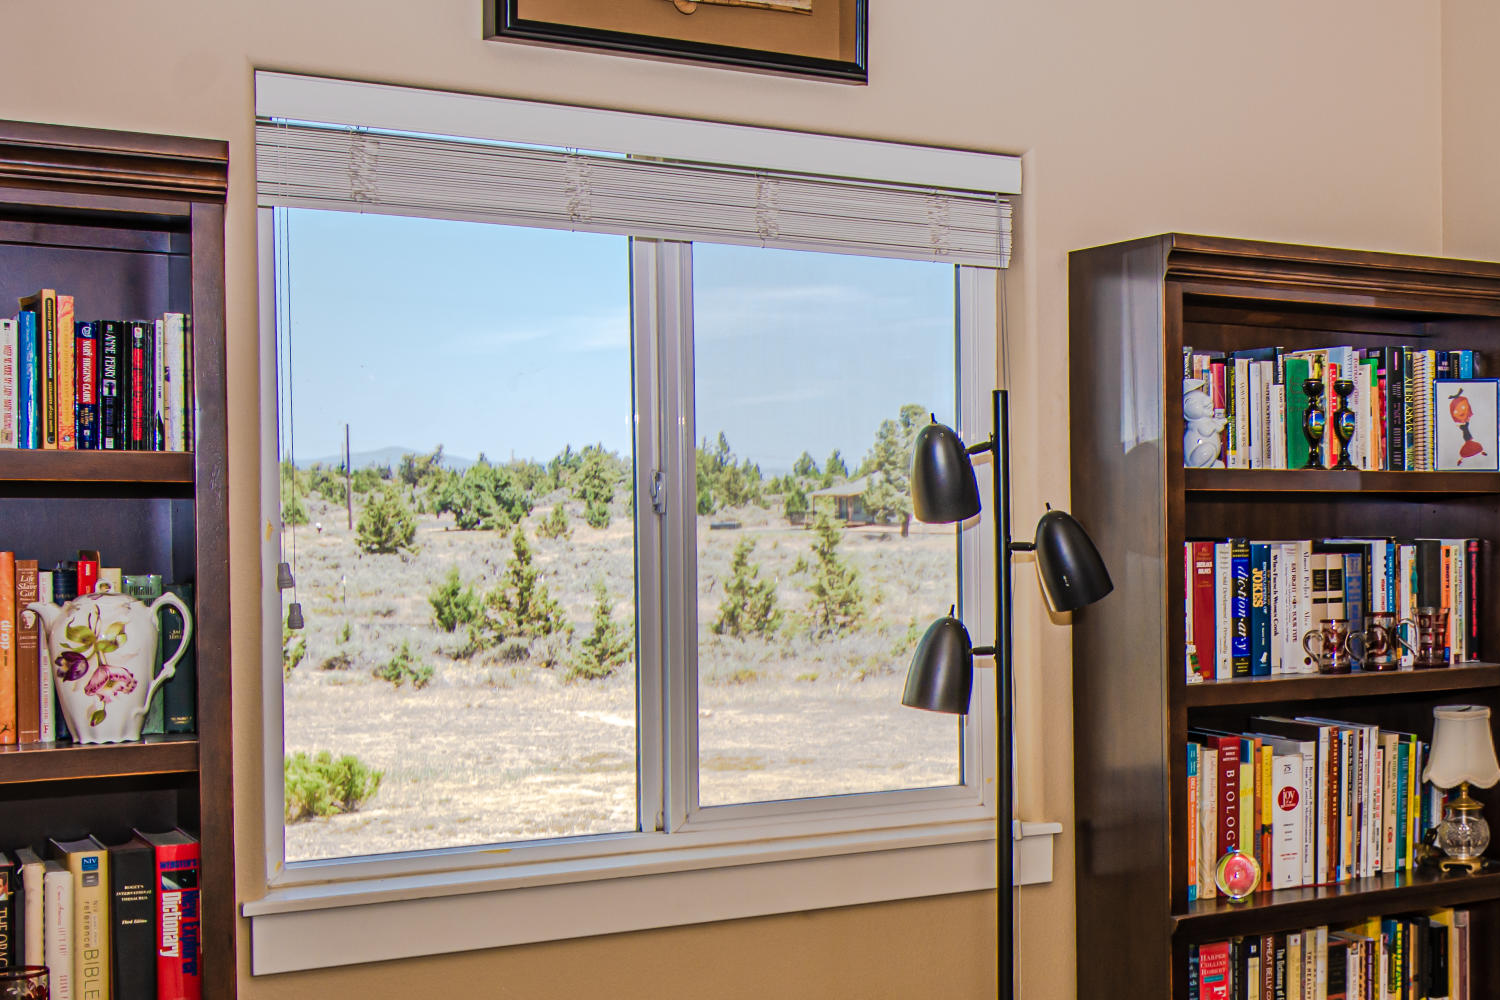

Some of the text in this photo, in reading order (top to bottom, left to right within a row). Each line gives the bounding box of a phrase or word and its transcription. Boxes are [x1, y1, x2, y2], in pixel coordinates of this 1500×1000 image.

[82, 339, 93, 357] MARY
[104, 333, 116, 379] ANNE PERRY
[82, 357, 92, 383] HIGGINS
[82, 383, 92, 403] CLARK
[1405, 405, 1414, 433] MARY
[1252, 567, 1264, 608] JOKES
[83, 901, 91, 948] reference
[159, 891, 182, 958] Dictionary
[179, 890, 199, 976] New Explorer
[1265, 937, 1273, 966] WHEAT
[84, 949, 100, 1000] BIBLE
[1265, 967, 1273, 990] BELLY
